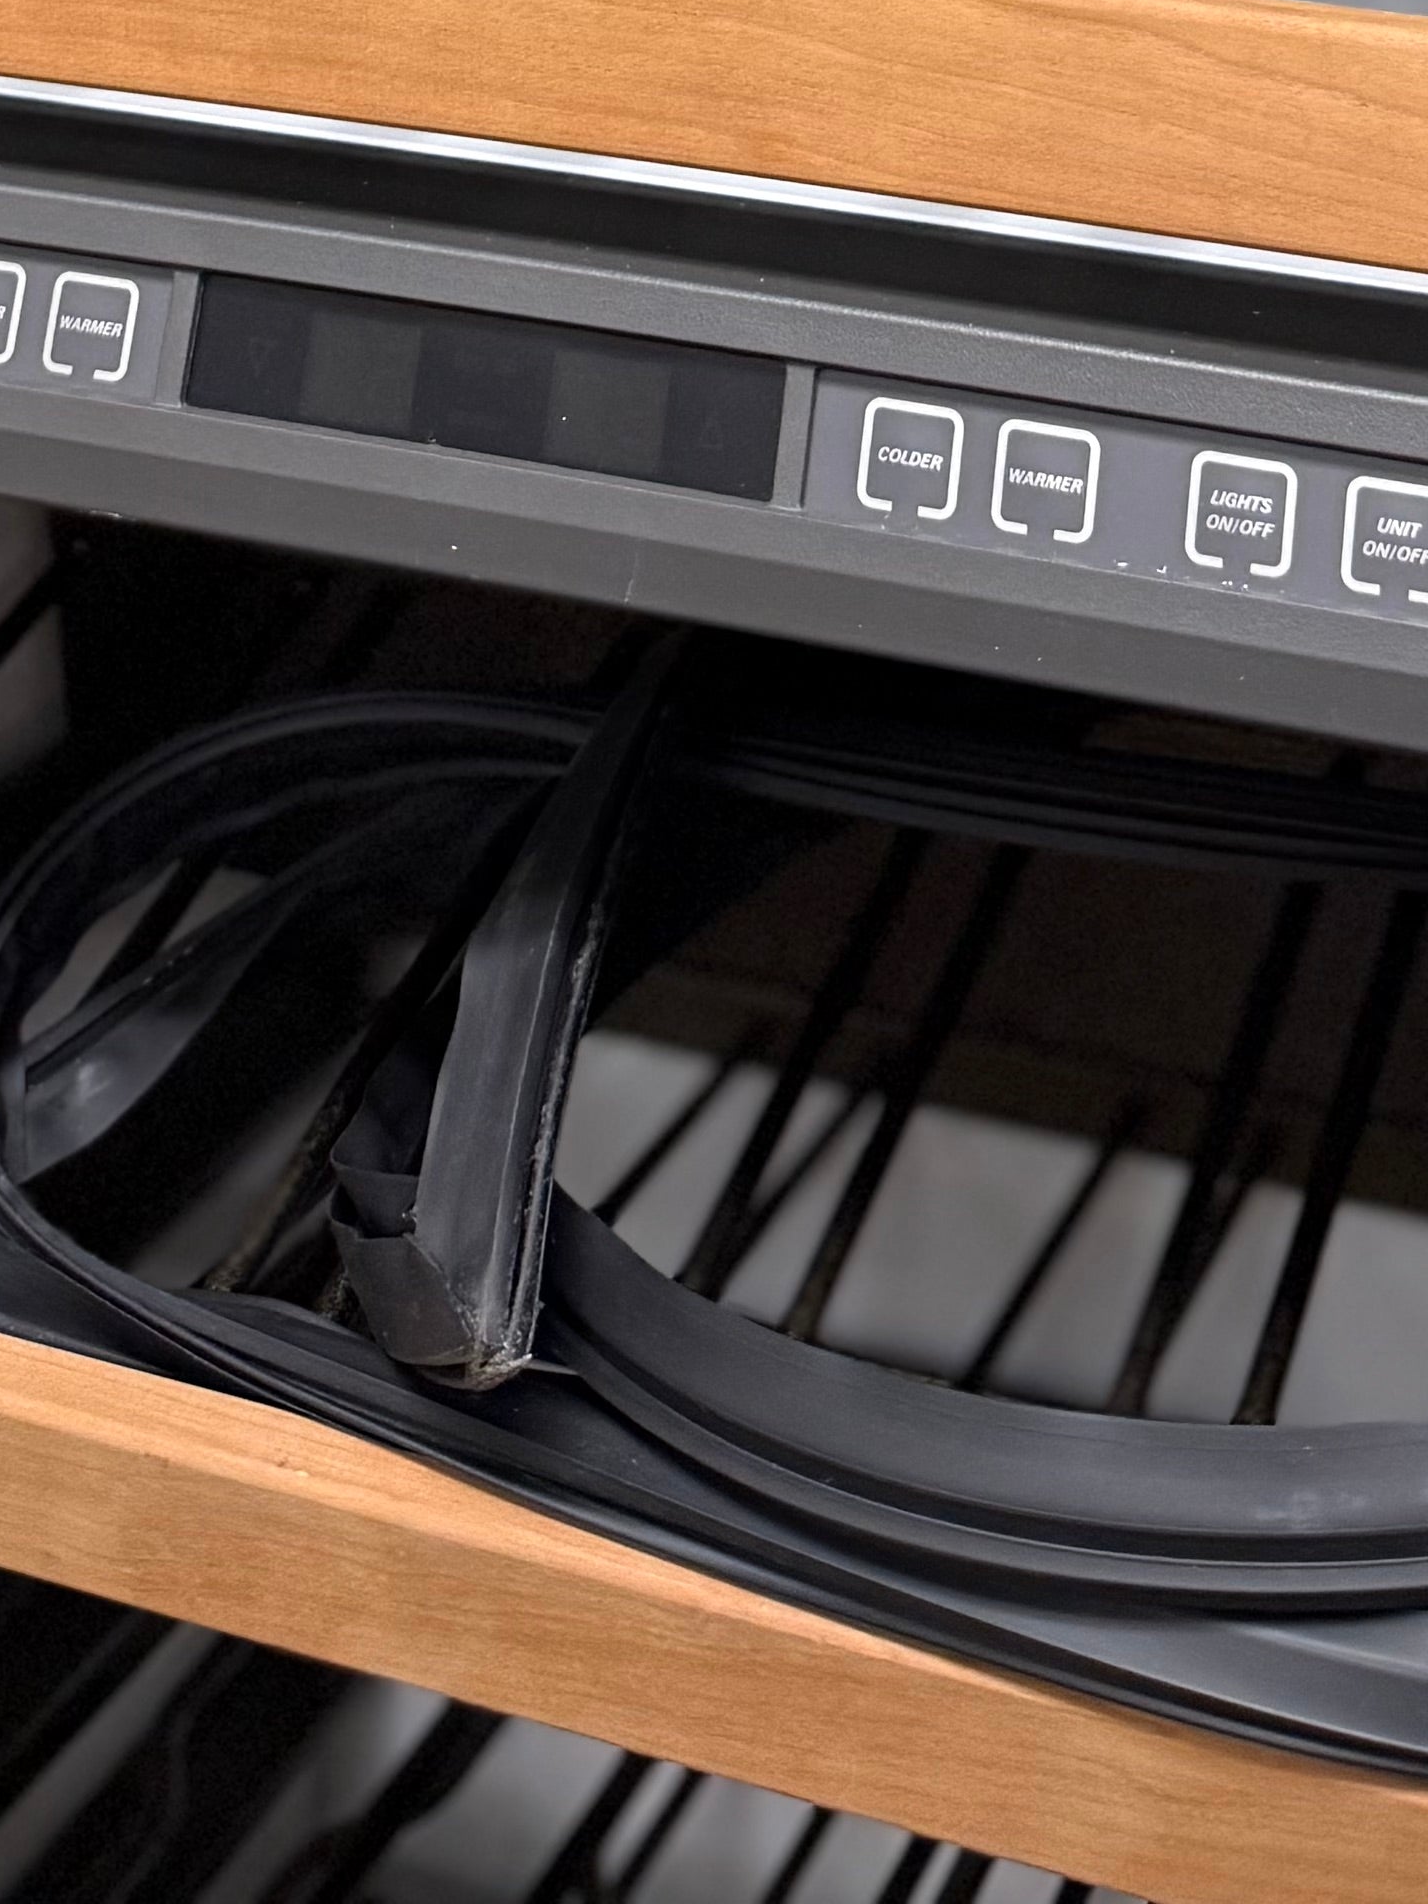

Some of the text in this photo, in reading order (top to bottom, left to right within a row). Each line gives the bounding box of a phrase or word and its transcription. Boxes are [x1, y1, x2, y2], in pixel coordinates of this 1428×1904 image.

[59, 314, 124, 339] WARMER
[877, 445, 945, 472] COLDER
[1008, 466, 1085, 495] WARMER
[1209, 488, 1274, 515] LIGHTS
[1205, 512, 1276, 539] ON/OFF
[1375, 516, 1423, 539] UNIT
